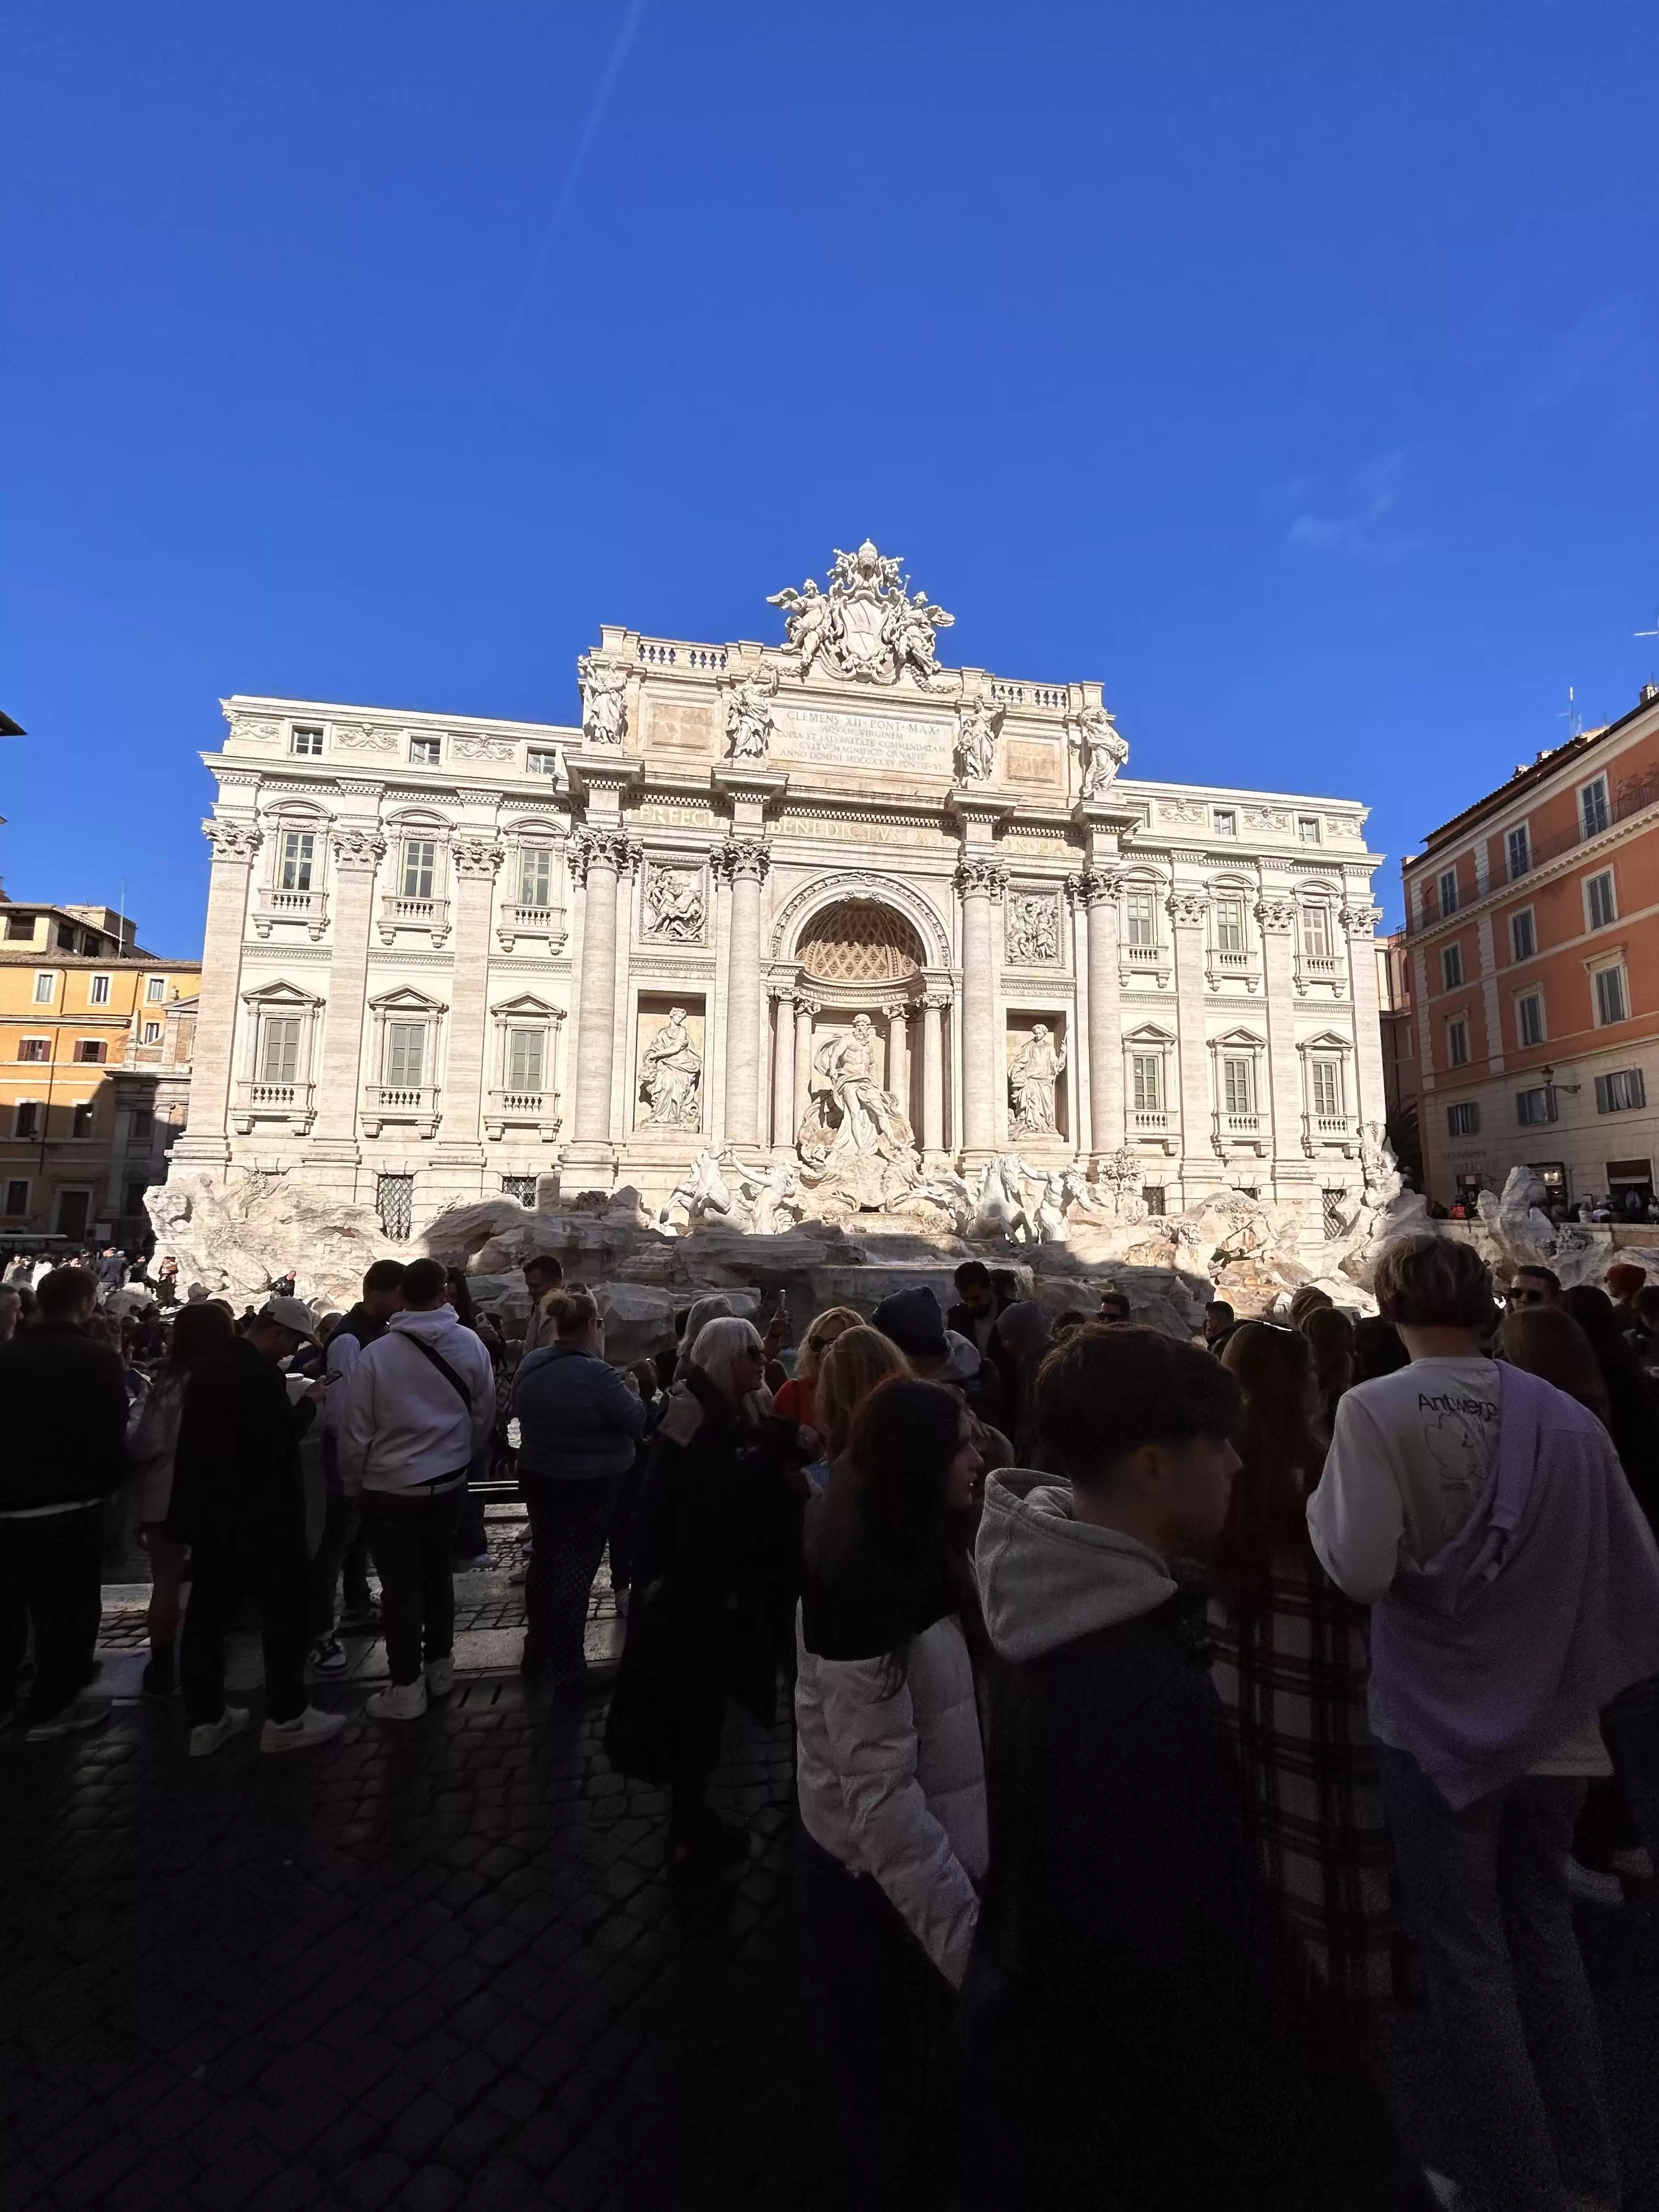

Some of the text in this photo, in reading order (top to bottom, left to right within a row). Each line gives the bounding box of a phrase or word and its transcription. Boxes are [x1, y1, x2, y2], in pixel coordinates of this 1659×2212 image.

[787, 710, 839, 725] CLEMENS
[859, 729, 904, 740] VIRGINEM
[833, 744, 883, 757] MAGNIFICO
[879, 741, 946, 753] COMMENDATAM
[780, 749, 807, 758] ANNO
[809, 752, 843, 762] DOMINI
[770, 818, 901, 842] BENEDICTVS
[1418, 1393, 1498, 1421] Antwerp
